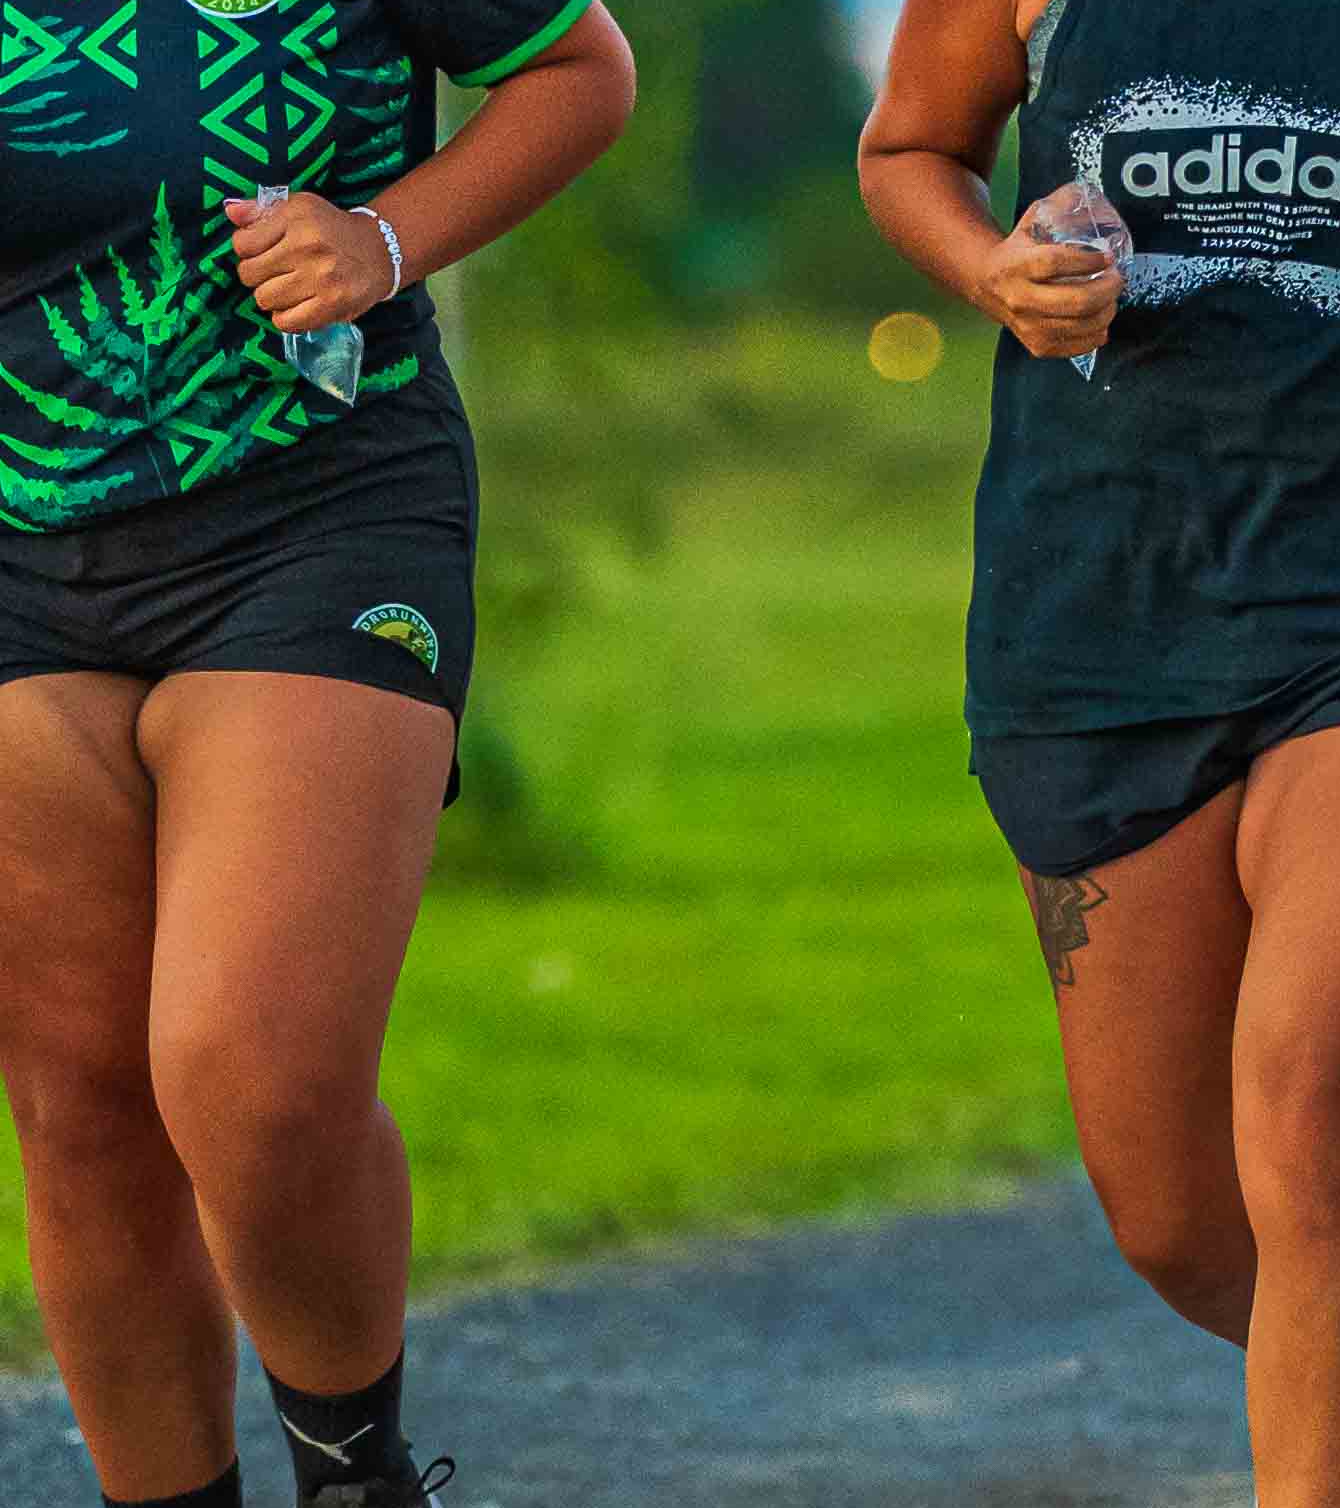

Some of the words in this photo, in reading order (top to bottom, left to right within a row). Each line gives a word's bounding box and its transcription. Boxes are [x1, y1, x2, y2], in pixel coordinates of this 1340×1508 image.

[1176, 202, 1194, 211] THE
[1197, 202, 1232, 211] BRAND
[1235, 201, 1261, 209] WITH
[1263, 202, 1281, 214] THE
[1247, 213, 1264, 221] MIT
[1187, 225, 1200, 233] LA
[1202, 225, 1244, 234] MARQUE
[1246, 226, 1267, 236] AUX
[1268, 229, 1274, 238] 3
